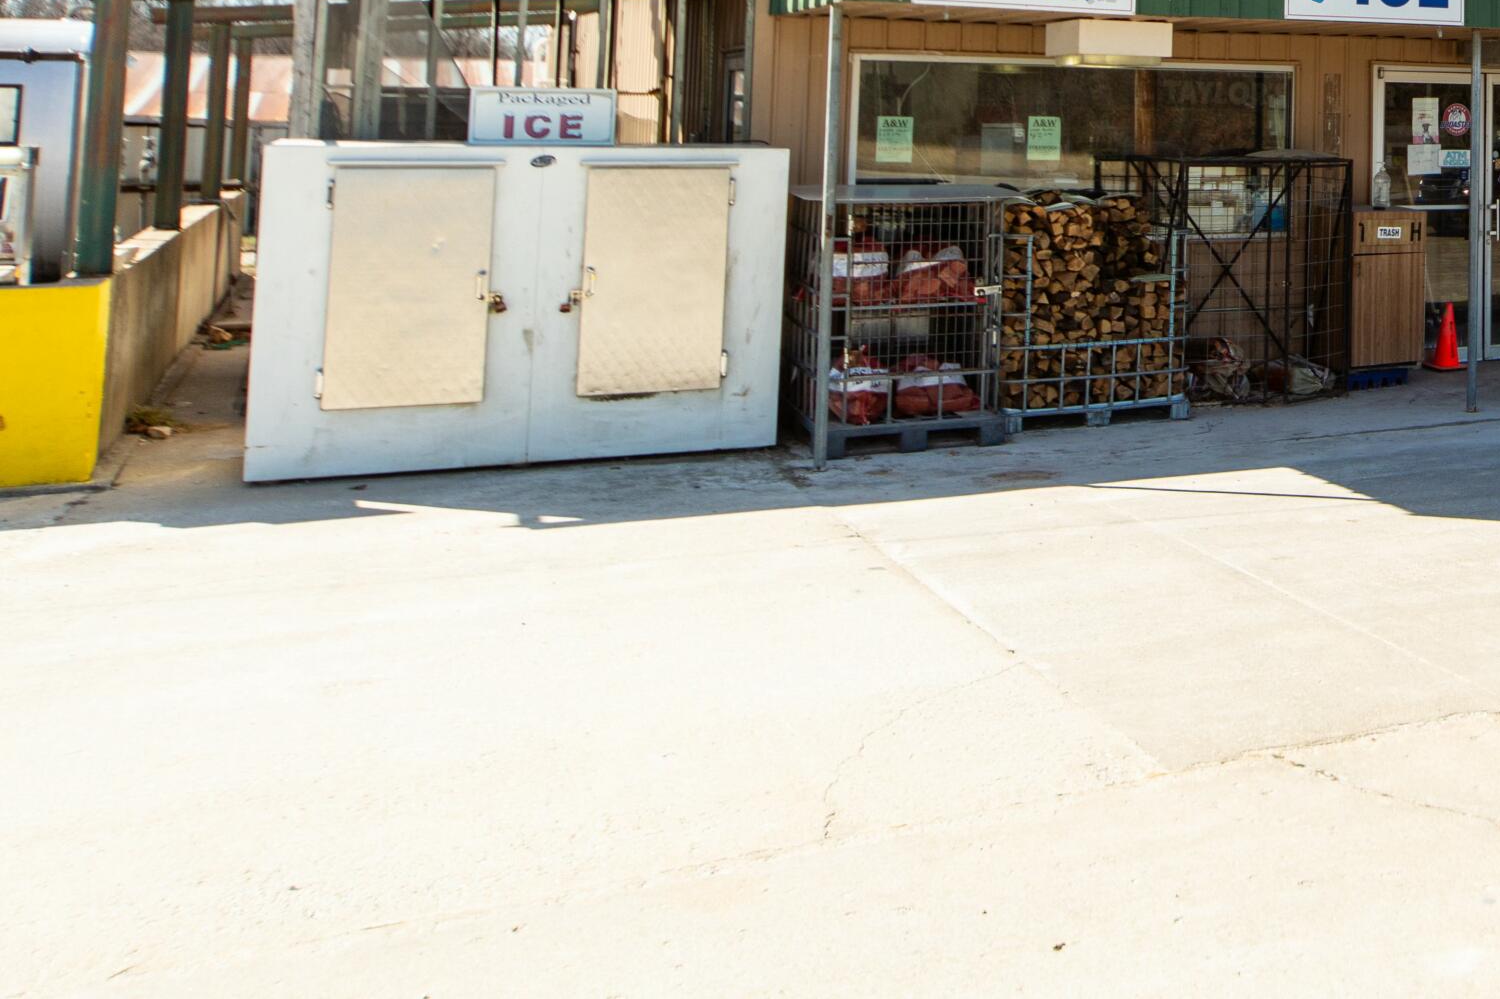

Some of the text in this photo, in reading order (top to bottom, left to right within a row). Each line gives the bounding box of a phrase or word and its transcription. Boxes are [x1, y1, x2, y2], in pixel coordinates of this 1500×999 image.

[497, 92, 592, 106] Packaged
[503, 114, 584, 139] ICE
[882, 119, 908, 128] A&W
[1032, 119, 1057, 128] A&W
[1446, 152, 1468, 160] ATM
[1379, 228, 1400, 237] TRASH
